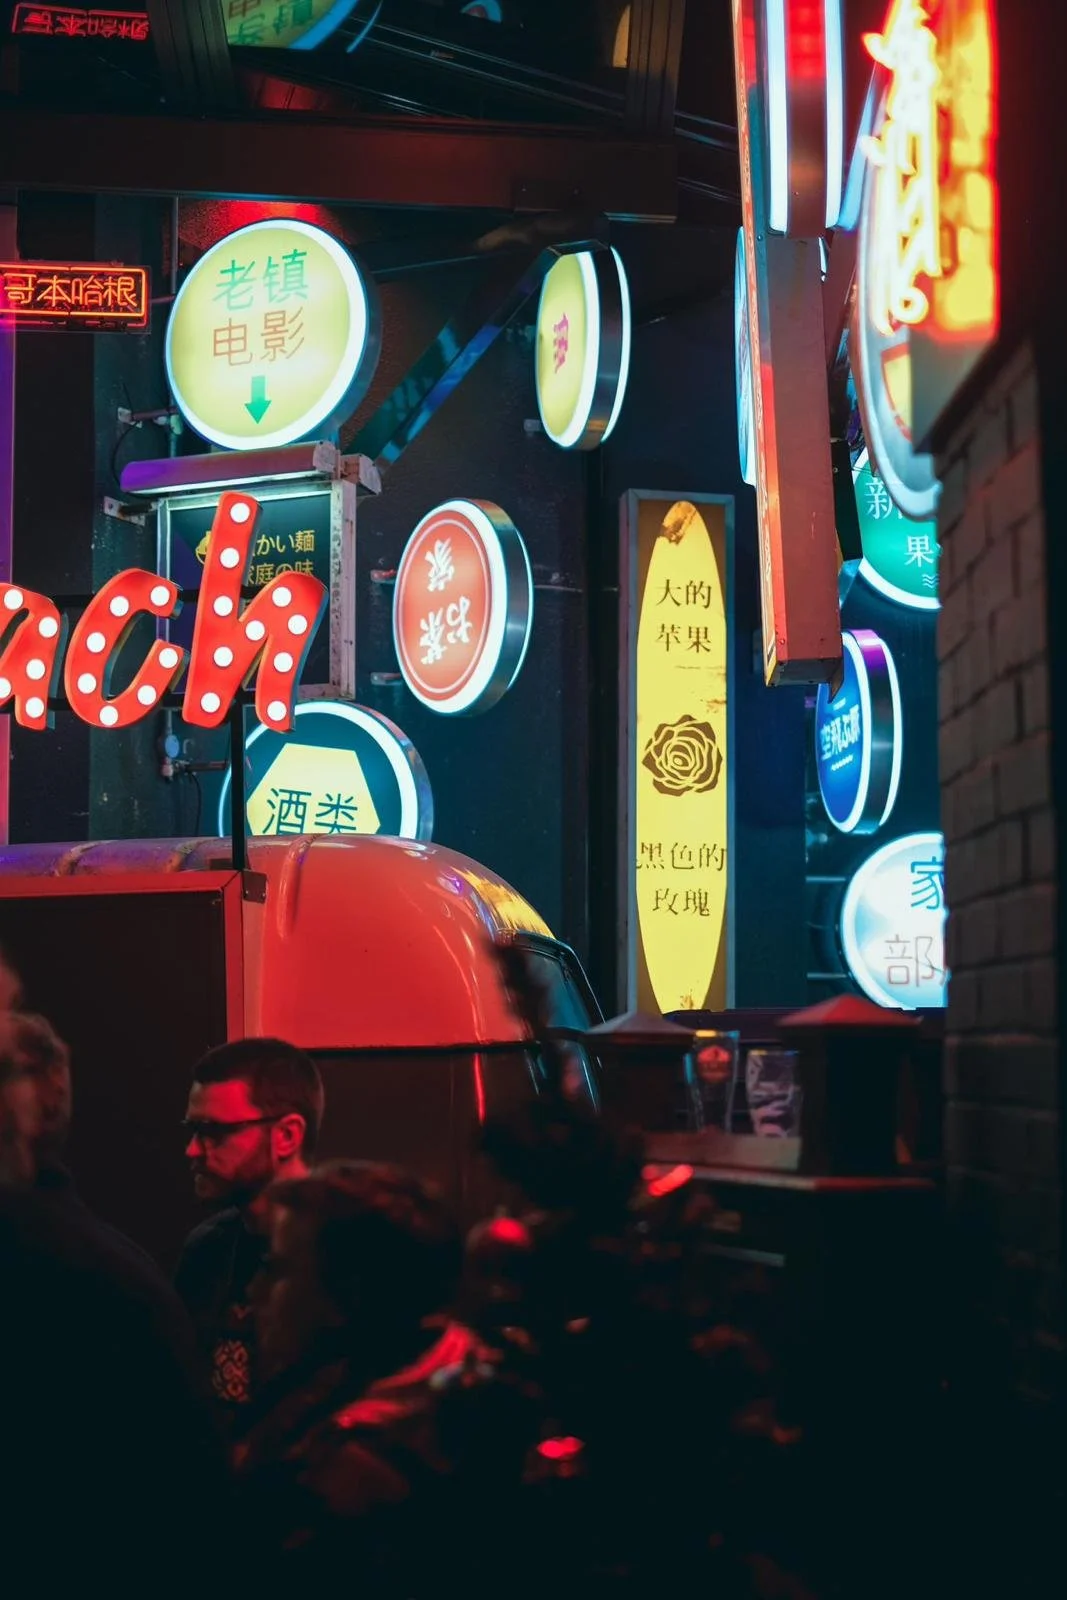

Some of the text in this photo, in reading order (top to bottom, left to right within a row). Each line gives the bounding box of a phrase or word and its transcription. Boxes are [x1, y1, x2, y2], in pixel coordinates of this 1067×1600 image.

[3, 272, 138, 308] 哥本哈根
[212, 248, 309, 311] 老镇
[212, 306, 305, 367] 电影
[864, 478, 903, 521] 新
[252, 529, 316, 557] かい麺
[904, 534, 943, 568] 果
[655, 578, 712, 610] 大的
[262, 786, 359, 836] 酒类
[636, 841, 727, 872] 黑色的
[652, 887, 711, 917] 玫瑰
